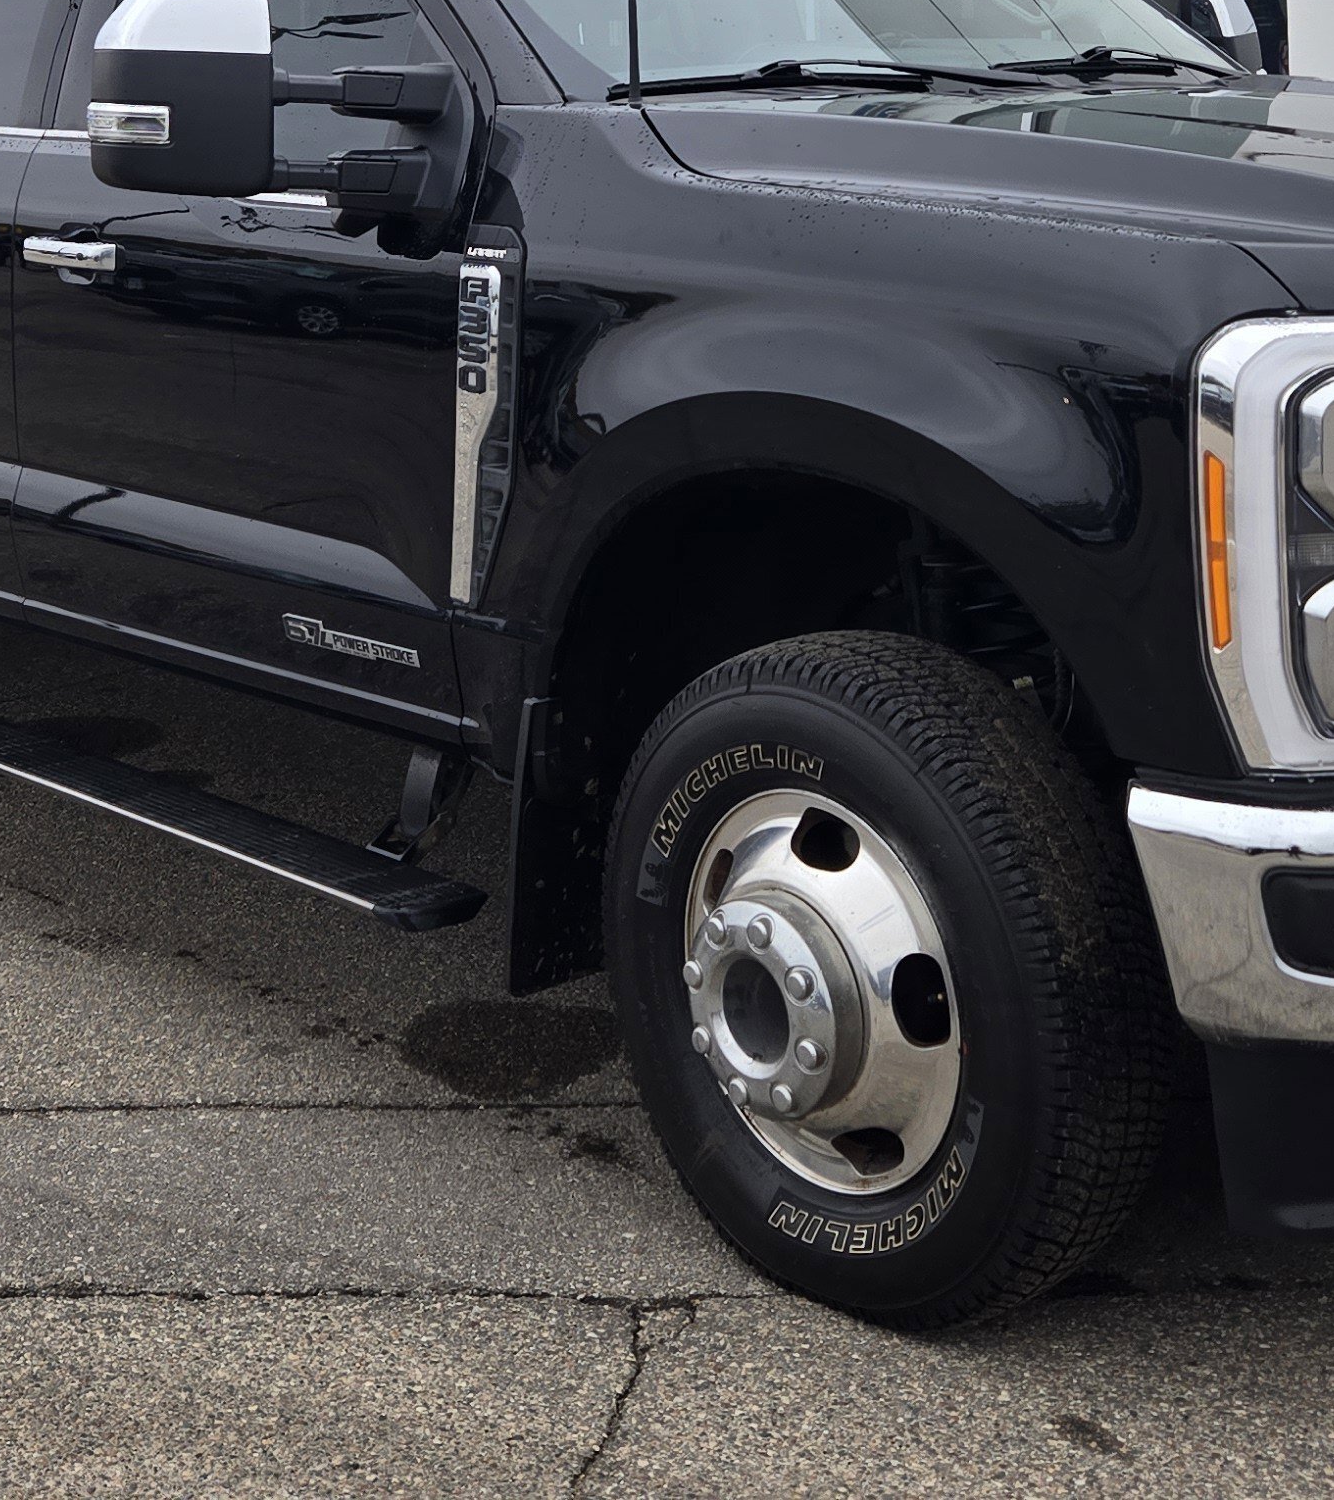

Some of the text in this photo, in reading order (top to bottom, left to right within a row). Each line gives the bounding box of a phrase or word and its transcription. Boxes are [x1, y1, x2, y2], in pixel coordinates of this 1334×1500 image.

[333, 635, 369, 654] POWER
[371, 643, 416, 666] STROKE
[651, 743, 825, 859] MICHELIN
[767, 1144, 967, 1254] MICHELIN
